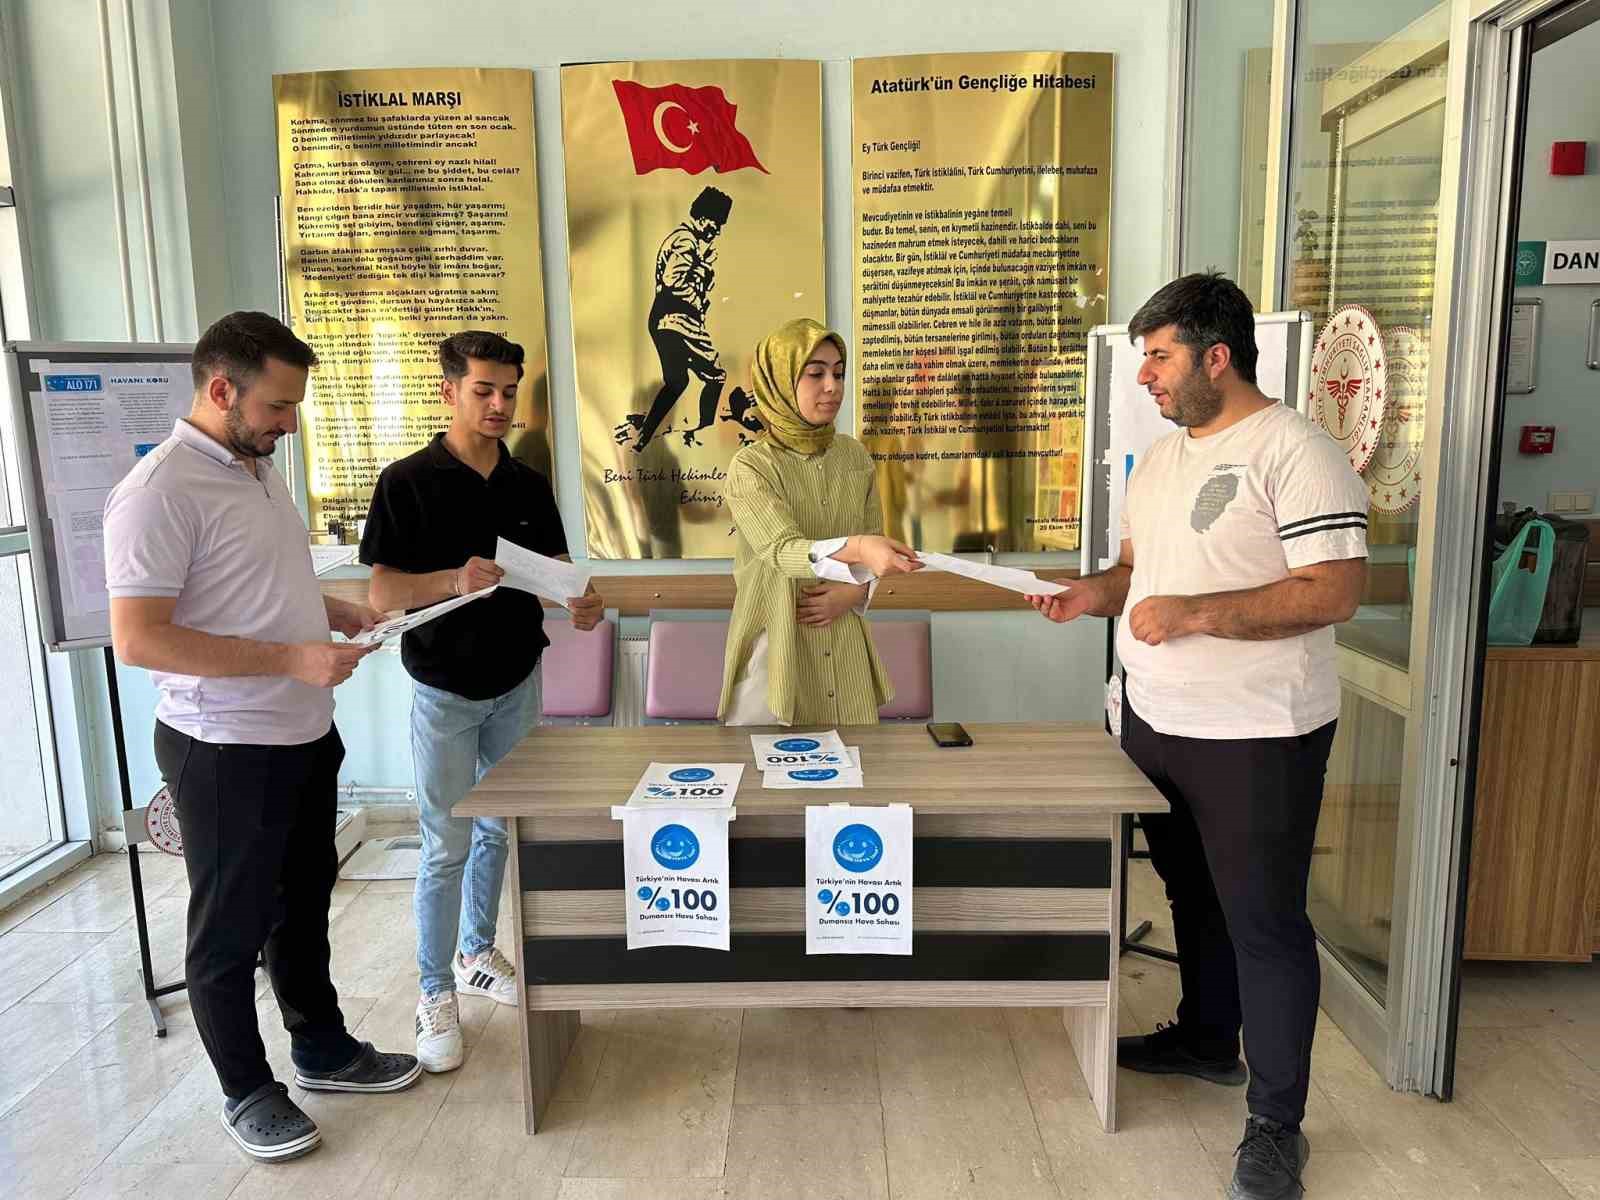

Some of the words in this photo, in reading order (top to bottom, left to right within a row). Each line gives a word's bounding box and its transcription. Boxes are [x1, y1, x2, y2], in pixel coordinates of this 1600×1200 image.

[871, 76, 953, 94] Atatürk'ün
[958, 73, 1028, 92] Gençliğe
[1032, 74, 1096, 89] Hitabesi
[338, 90, 408, 107] İSTİKLAL
[412, 91, 462, 110] MARŞI
[862, 143, 871, 154] Ey
[872, 142, 888, 152] Türk
[890, 140, 921, 152] Gençliği!
[914, 168, 930, 178] Türk
[968, 166, 984, 177] Türk
[862, 186, 870, 195] ve
[915, 212, 923, 220] ve
[885, 226, 894, 235] Bu
[895, 252, 906, 262] Bir
[1553, 252, 1600, 270] DAN
[604, 468, 632, 483] Beni
[636, 468, 666, 481] Türk
[680, 489, 725, 507] Ediniz
[647, 787, 724, 796] %100
[636, 875, 675, 883] Türkiye'nin
[816, 878, 856, 886] Türkiye'nin
[884, 879, 902, 887] Artık
[637, 886, 717, 911] %100
[817, 889, 900, 916] %100
[639, 913, 673, 921] Dumansız
[695, 913, 718, 921] Sahası
[876, 918, 900, 926] Sahası
